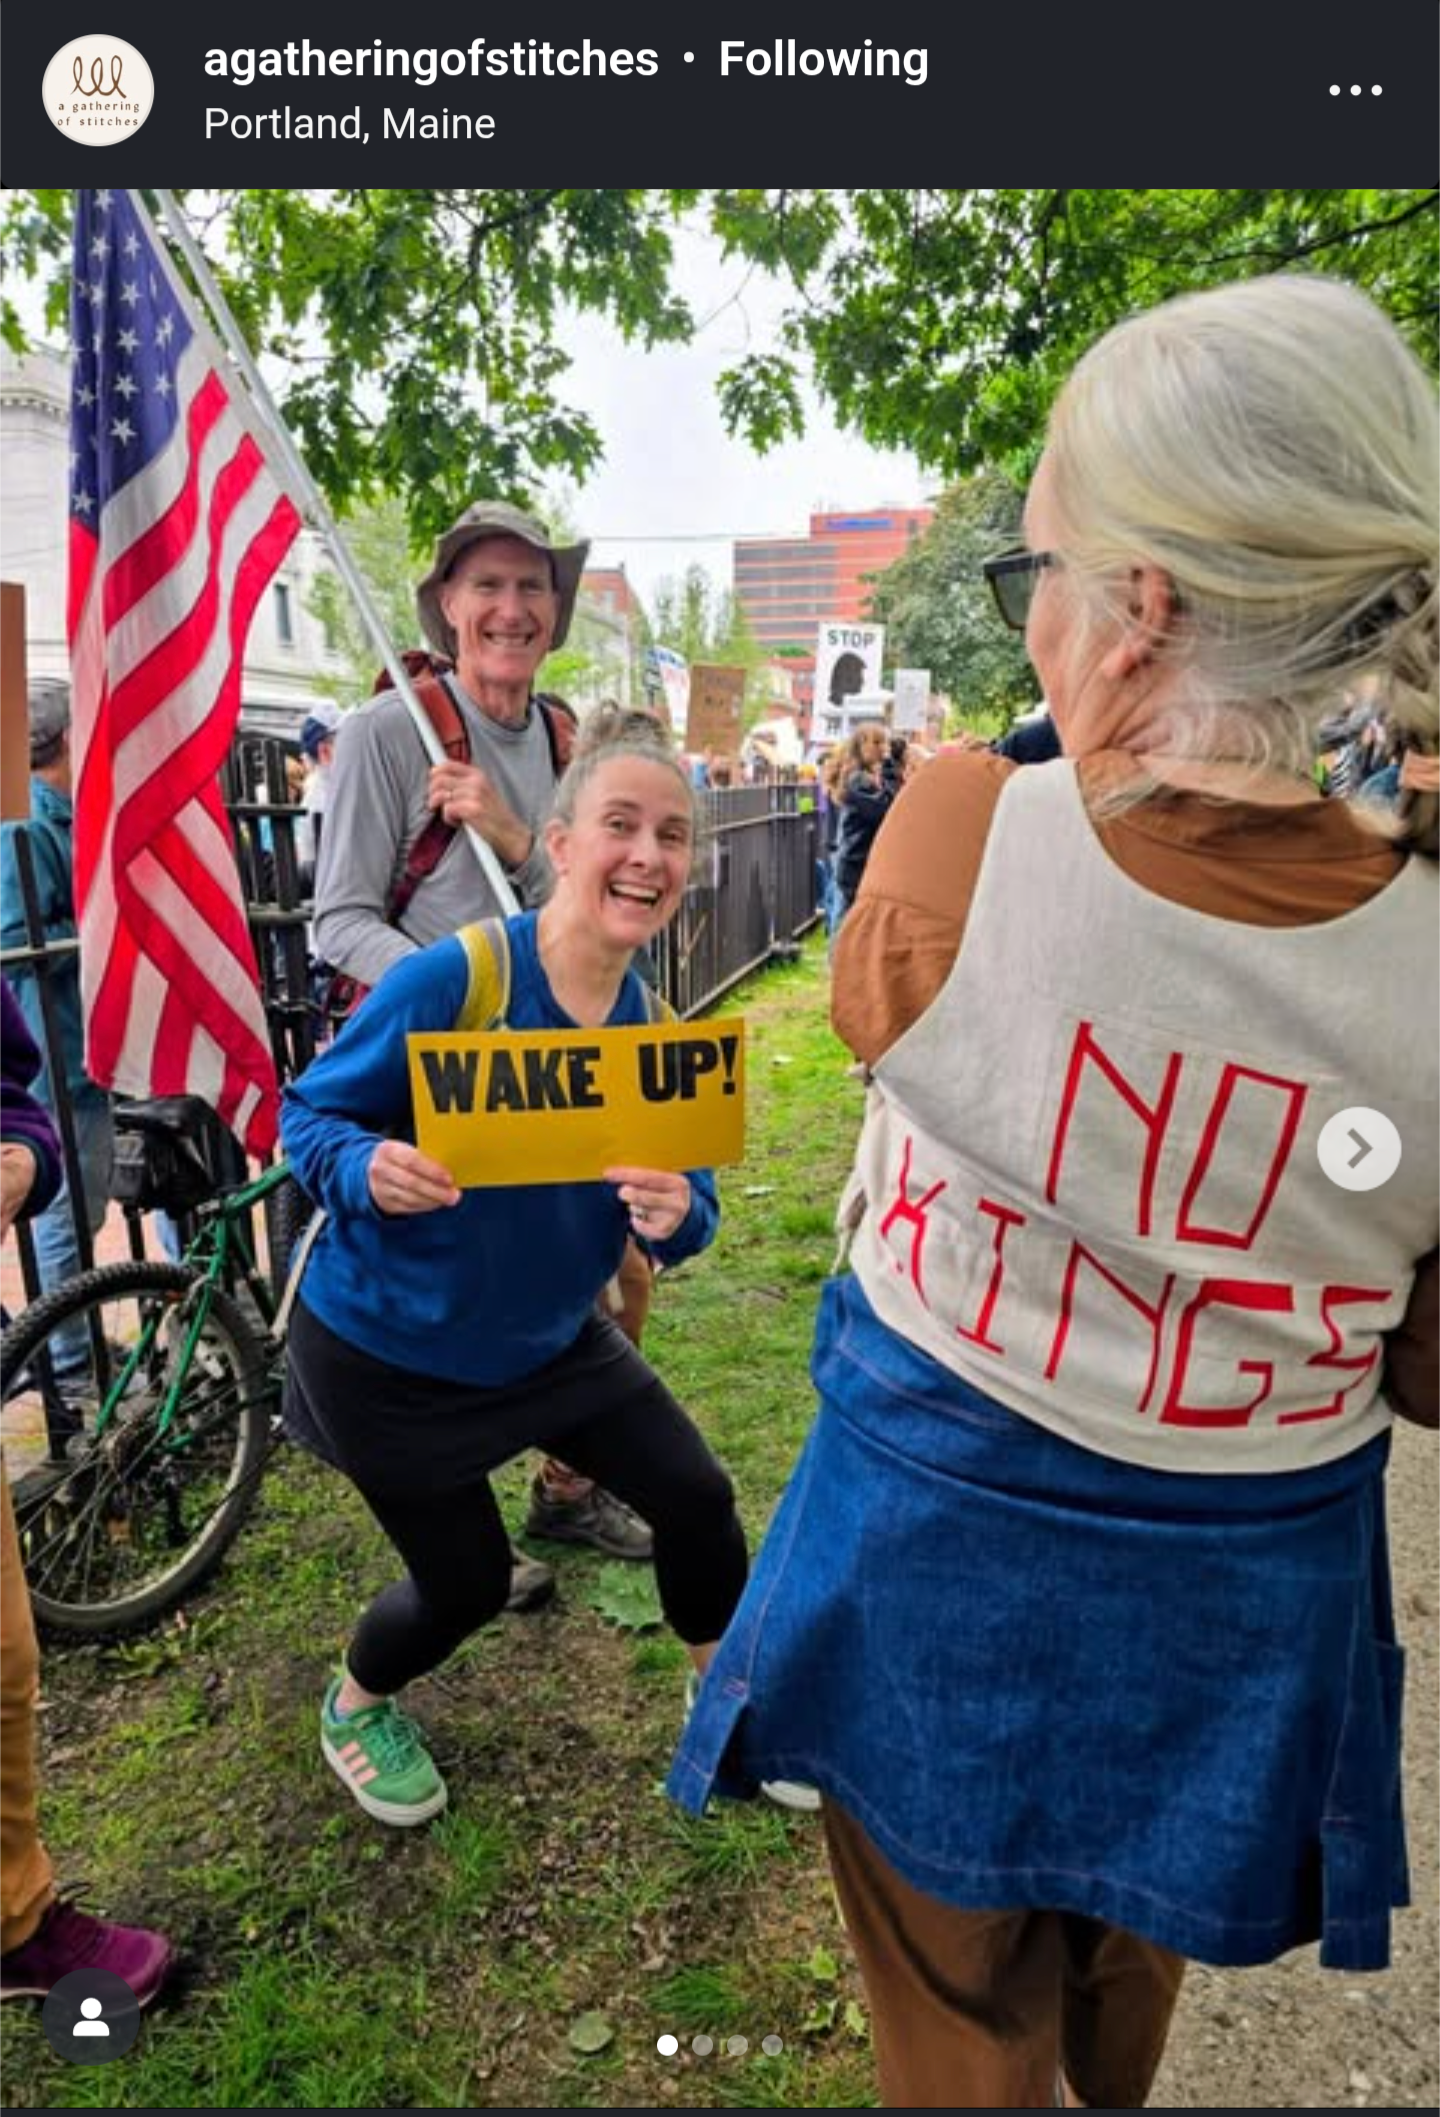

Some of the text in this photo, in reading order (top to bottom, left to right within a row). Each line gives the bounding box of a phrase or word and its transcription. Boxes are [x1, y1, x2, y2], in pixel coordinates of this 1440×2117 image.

[827, 629, 875, 648] STOP
[420, 1035, 738, 1114] WAKE UP!
[1046, 1021, 1308, 1250] NO
[880, 1135, 1393, 1428] KINGS
